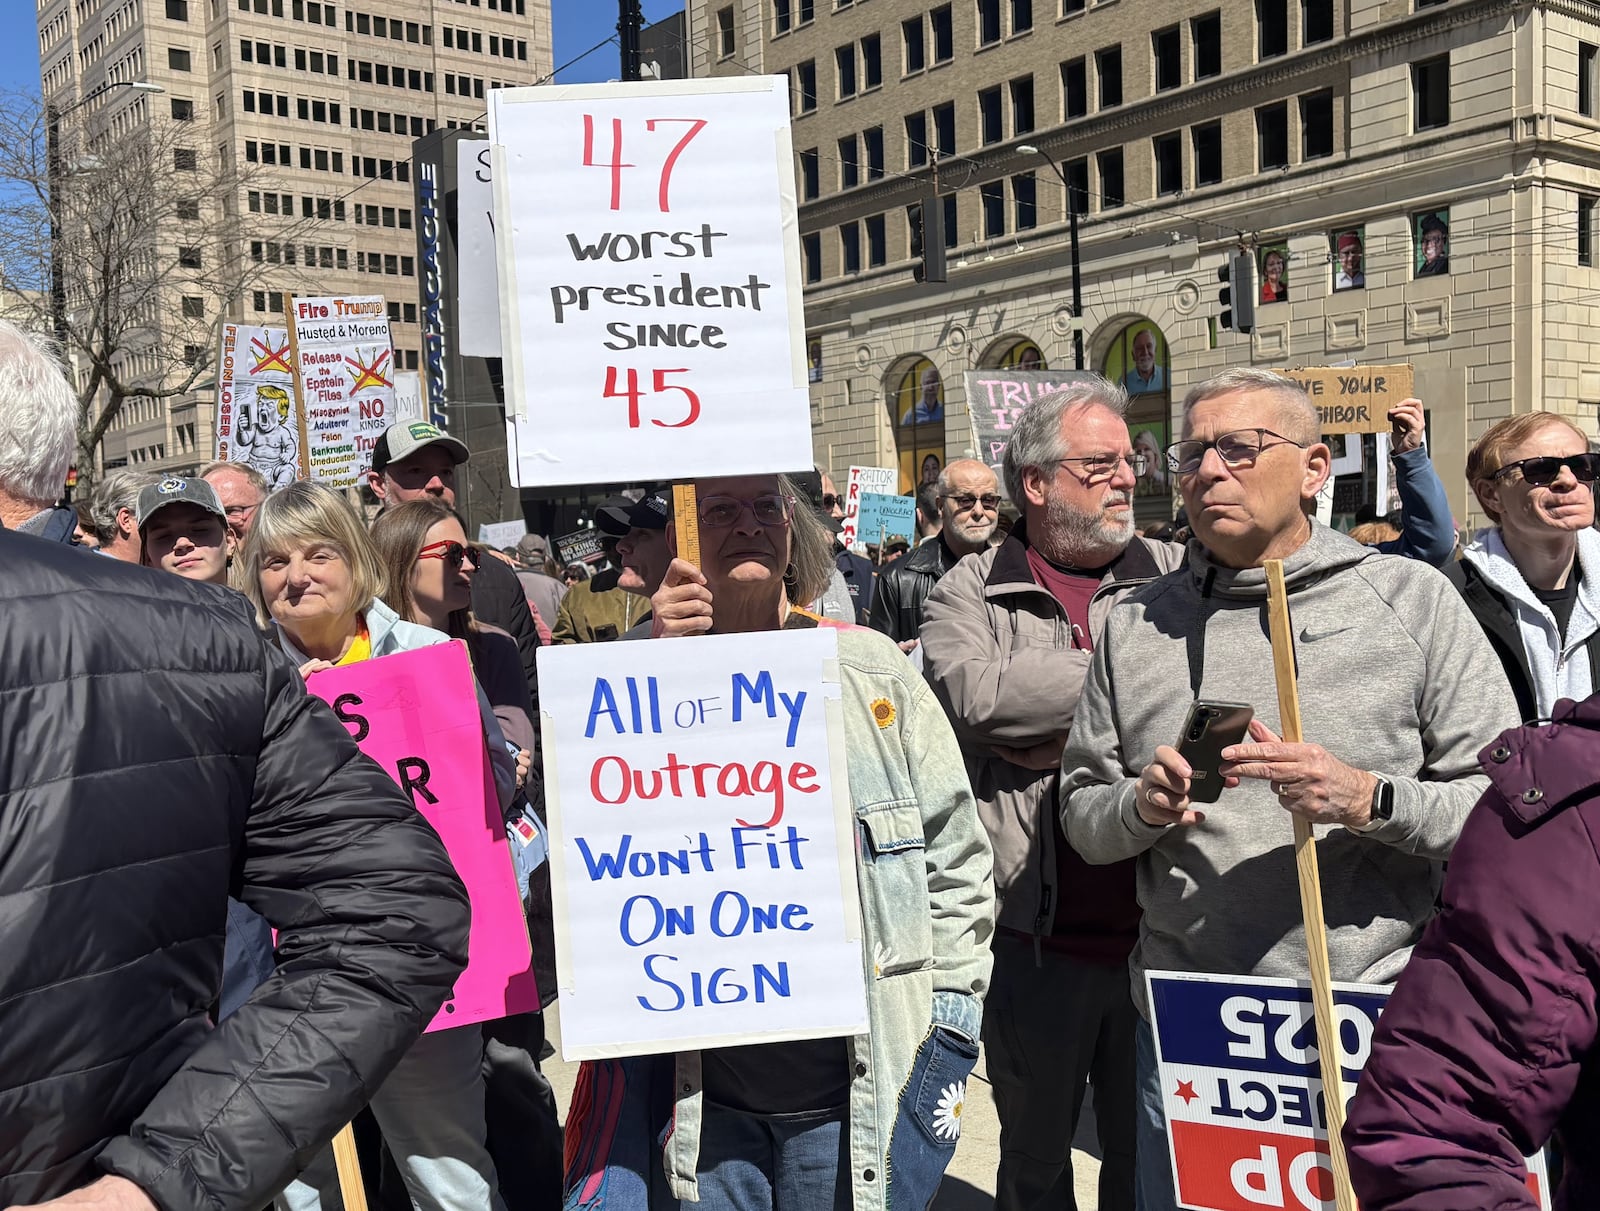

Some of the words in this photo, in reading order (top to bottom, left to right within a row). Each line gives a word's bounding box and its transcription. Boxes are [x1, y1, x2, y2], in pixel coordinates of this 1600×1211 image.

[583, 114, 709, 213] 47
[566, 223, 728, 262] worst
[420, 162, 449, 431] TRATACACHE
[550, 272, 771, 323] president
[298, 303, 329, 319] Fire
[333, 300, 383, 317] Trump
[297, 325, 336, 340] Husted
[338, 325, 346, 337] &
[348, 324, 387, 337] Moreno
[222, 325, 237, 381] FELON
[302, 352, 342, 366] Release
[319, 367, 331, 375] the
[306, 376, 344, 391] Epstein
[1337, 375, 1388, 395] YOUR
[318, 390, 342, 401] Files
[603, 365, 701, 428] 45
[218, 382, 233, 437] LOSER
[309, 406, 350, 419] Misogynist
[358, 398, 385, 420] NO
[1316, 405, 1371, 424] GHBOR
[313, 419, 350, 431] Adulterer
[360, 419, 386, 431] KINGS
[321, 433, 342, 443] Felon
[354, 435, 381, 452] Tru
[218, 441, 229, 462] GR
[310, 453, 356, 466] Uneducated
[319, 465, 350, 477] Dropout
[332, 477, 358, 488] Dodger
[571, 546, 601, 560] AMERIC
[584, 676, 663, 738] All
[731, 670, 808, 748] My
[589, 752, 822, 828] Outrage
[732, 825, 810, 870] Fit
[636, 953, 791, 1012] SIGN
[1220, 996, 1384, 1071] 025
[1211, 1079, 1327, 1129] JECT
[1230, 1145, 1335, 1211] OP
